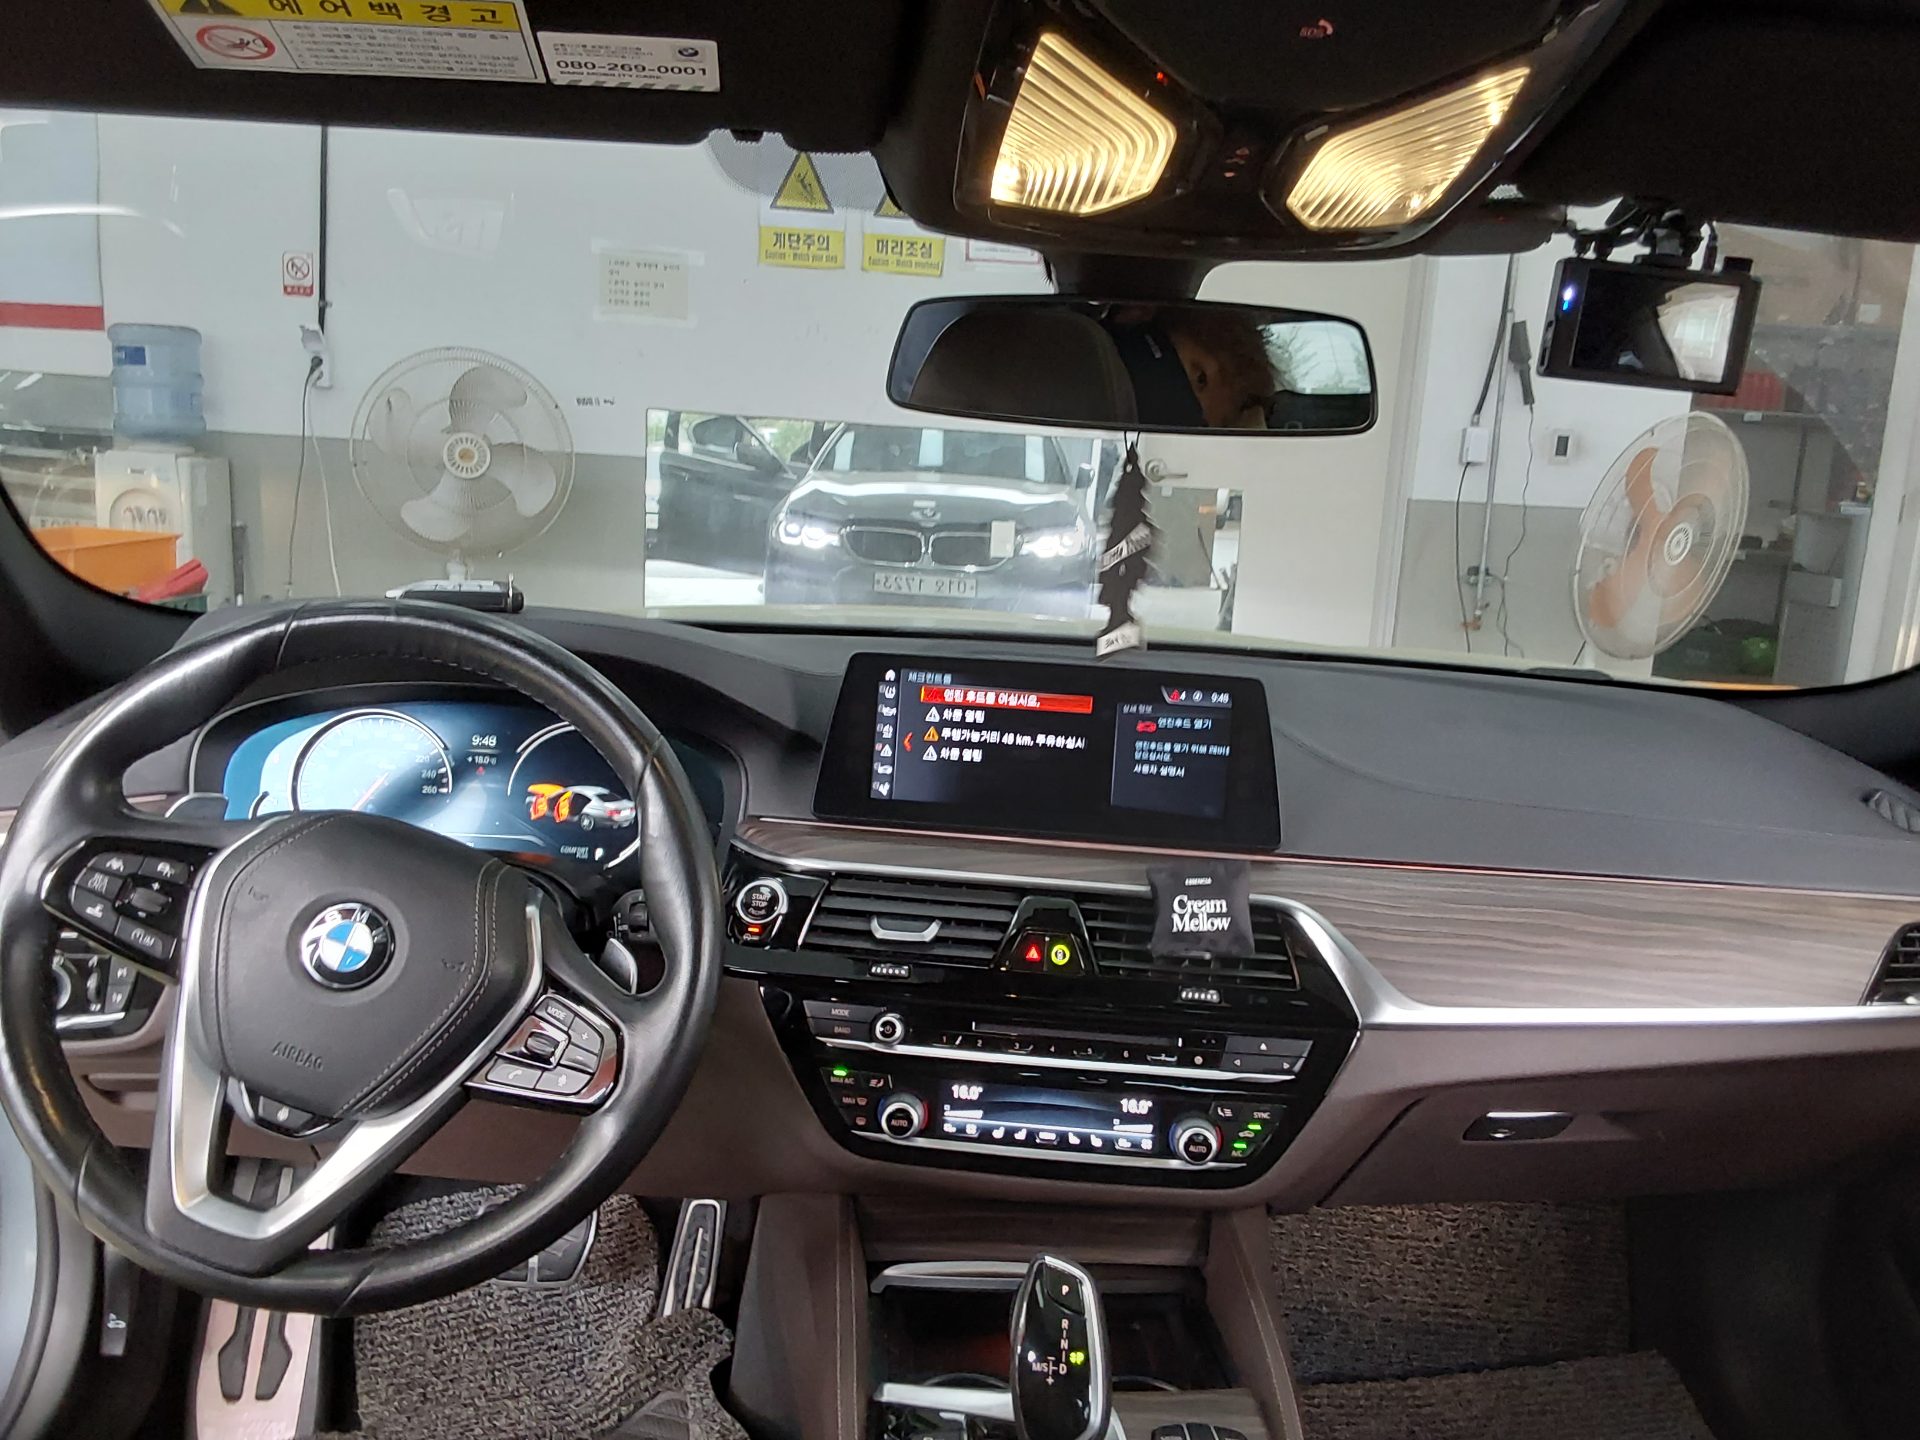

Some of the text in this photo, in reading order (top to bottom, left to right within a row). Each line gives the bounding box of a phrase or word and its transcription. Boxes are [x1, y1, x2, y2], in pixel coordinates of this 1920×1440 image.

[556, 60, 707, 76] 080-269-0001
[773, 231, 830, 251] 계단주의
[876, 239, 932, 259] 머리조심
[1173, 894, 1228, 914] Cream
[1171, 912, 1231, 933] Mellow
[546, 1005, 568, 1020] MODE
[272, 1041, 322, 1070] AIRBAG
[1253, 1111, 1271, 1119] SYNC
[890, 1119, 908, 1127] AUTO
[1188, 1144, 1207, 1153] AUTO
[1061, 1284, 1070, 1296] P
[1061, 1318, 1069, 1330] R
[1060, 1338, 1069, 1350] N
[1059, 1362, 1068, 1375] D
